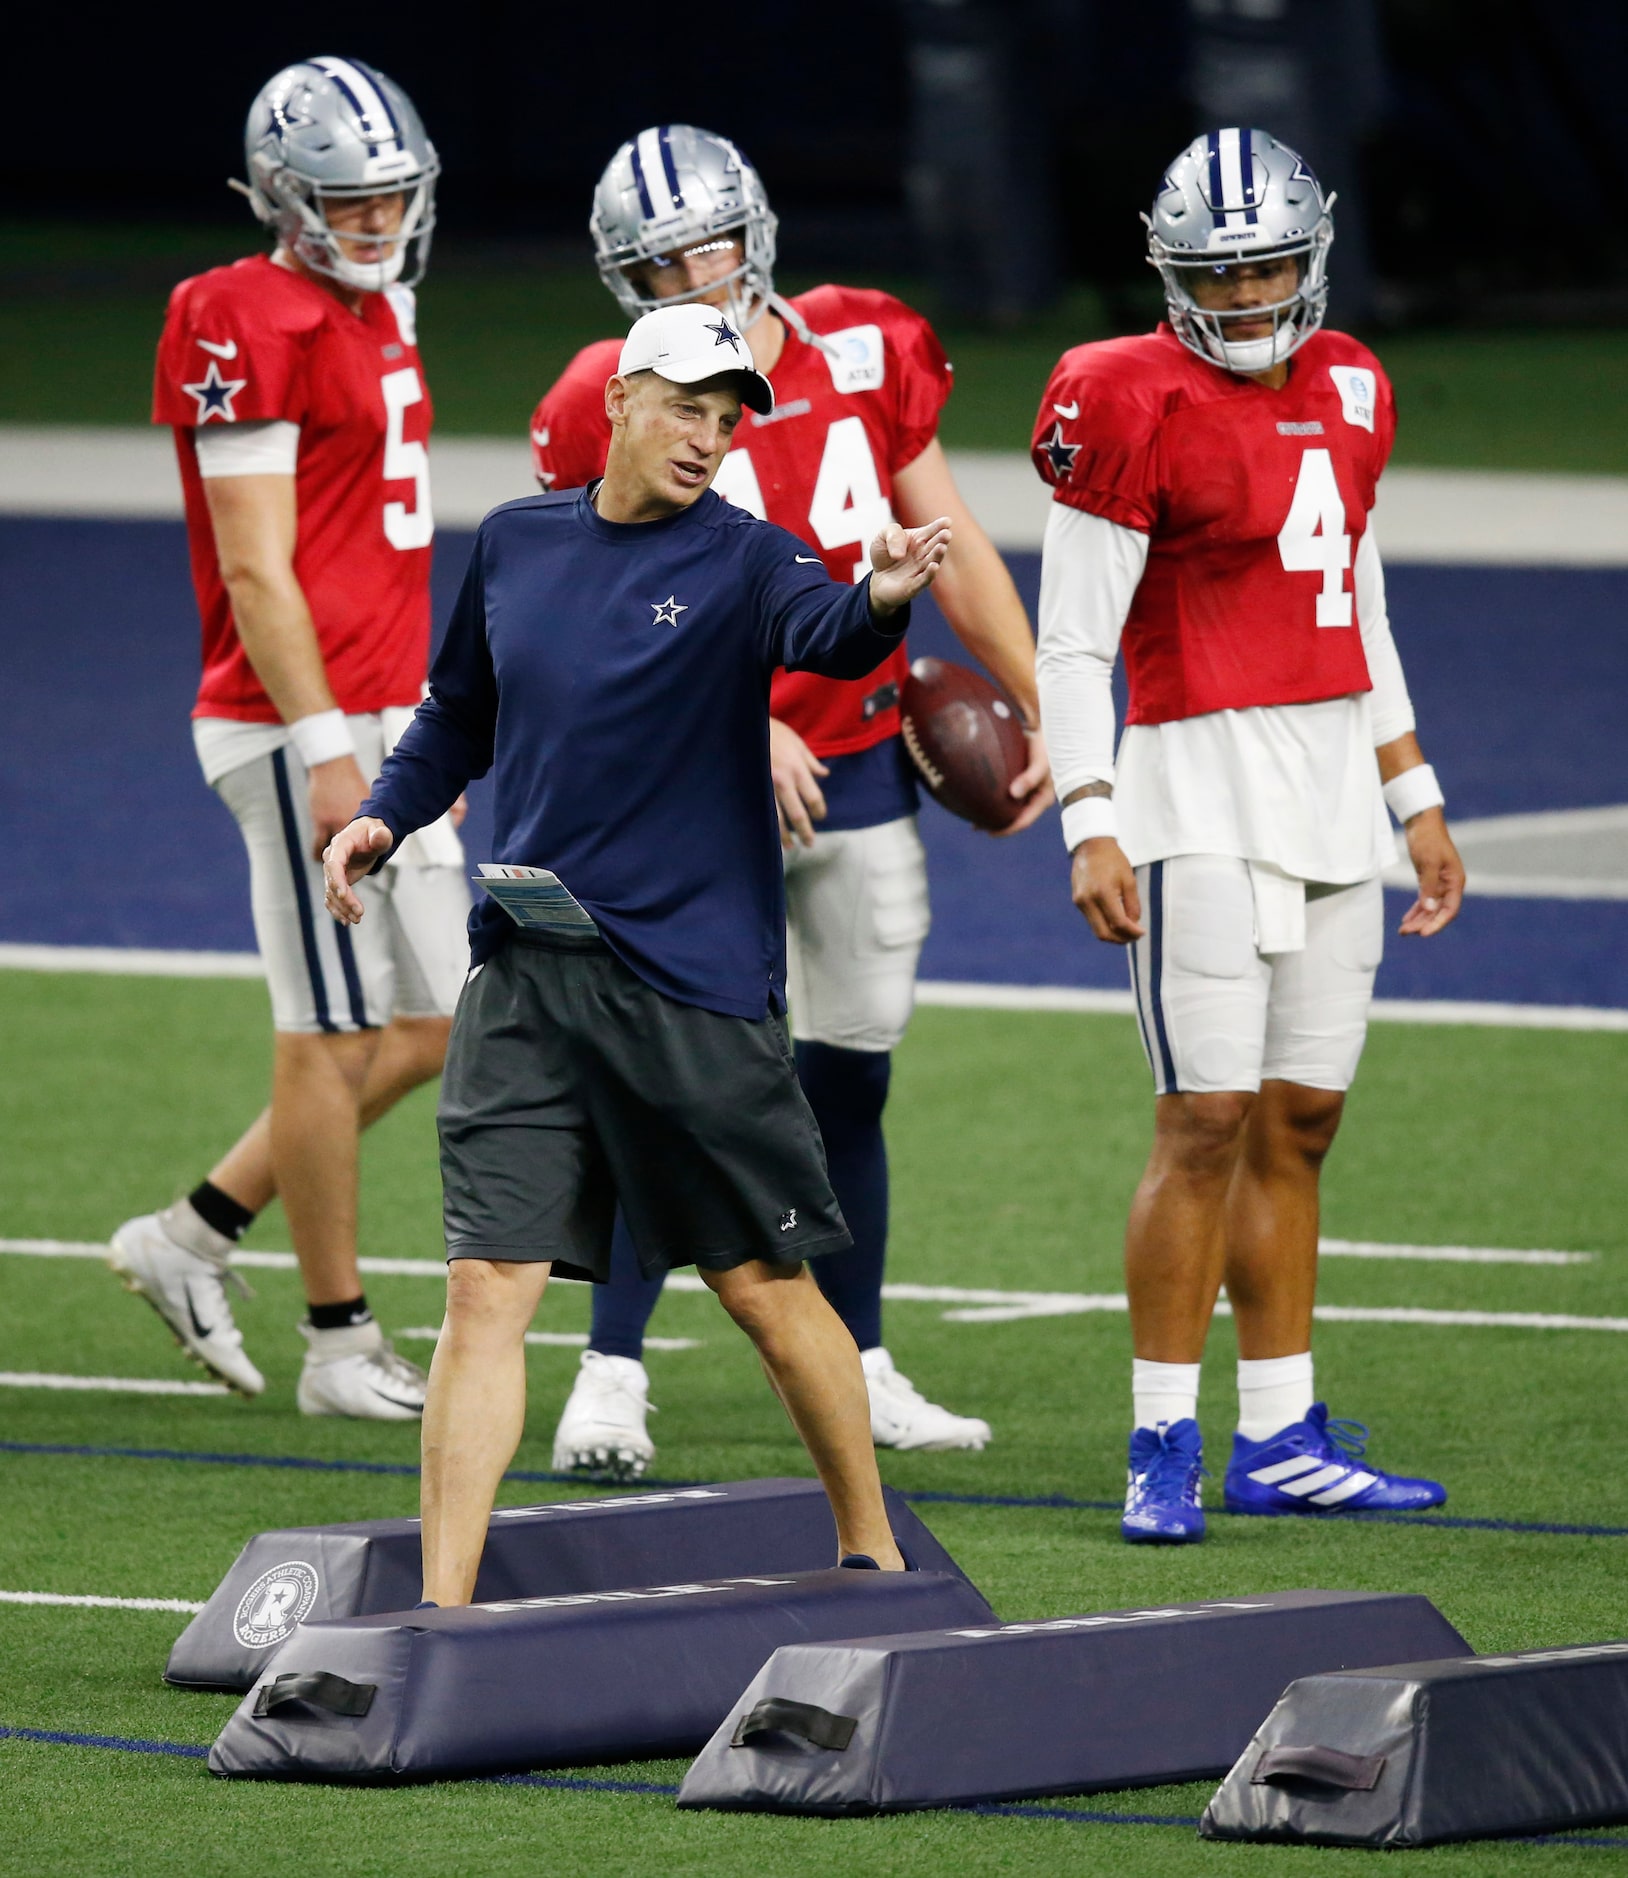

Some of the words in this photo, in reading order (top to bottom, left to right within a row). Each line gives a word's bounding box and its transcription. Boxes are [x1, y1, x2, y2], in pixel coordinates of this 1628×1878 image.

[381, 366, 435, 551] 5
[1277, 448, 1352, 628] 4
[266, 1567, 307, 1585] ATHLETIC
[250, 1579, 300, 1629] R
[238, 1623, 288, 1643] ROGERS
